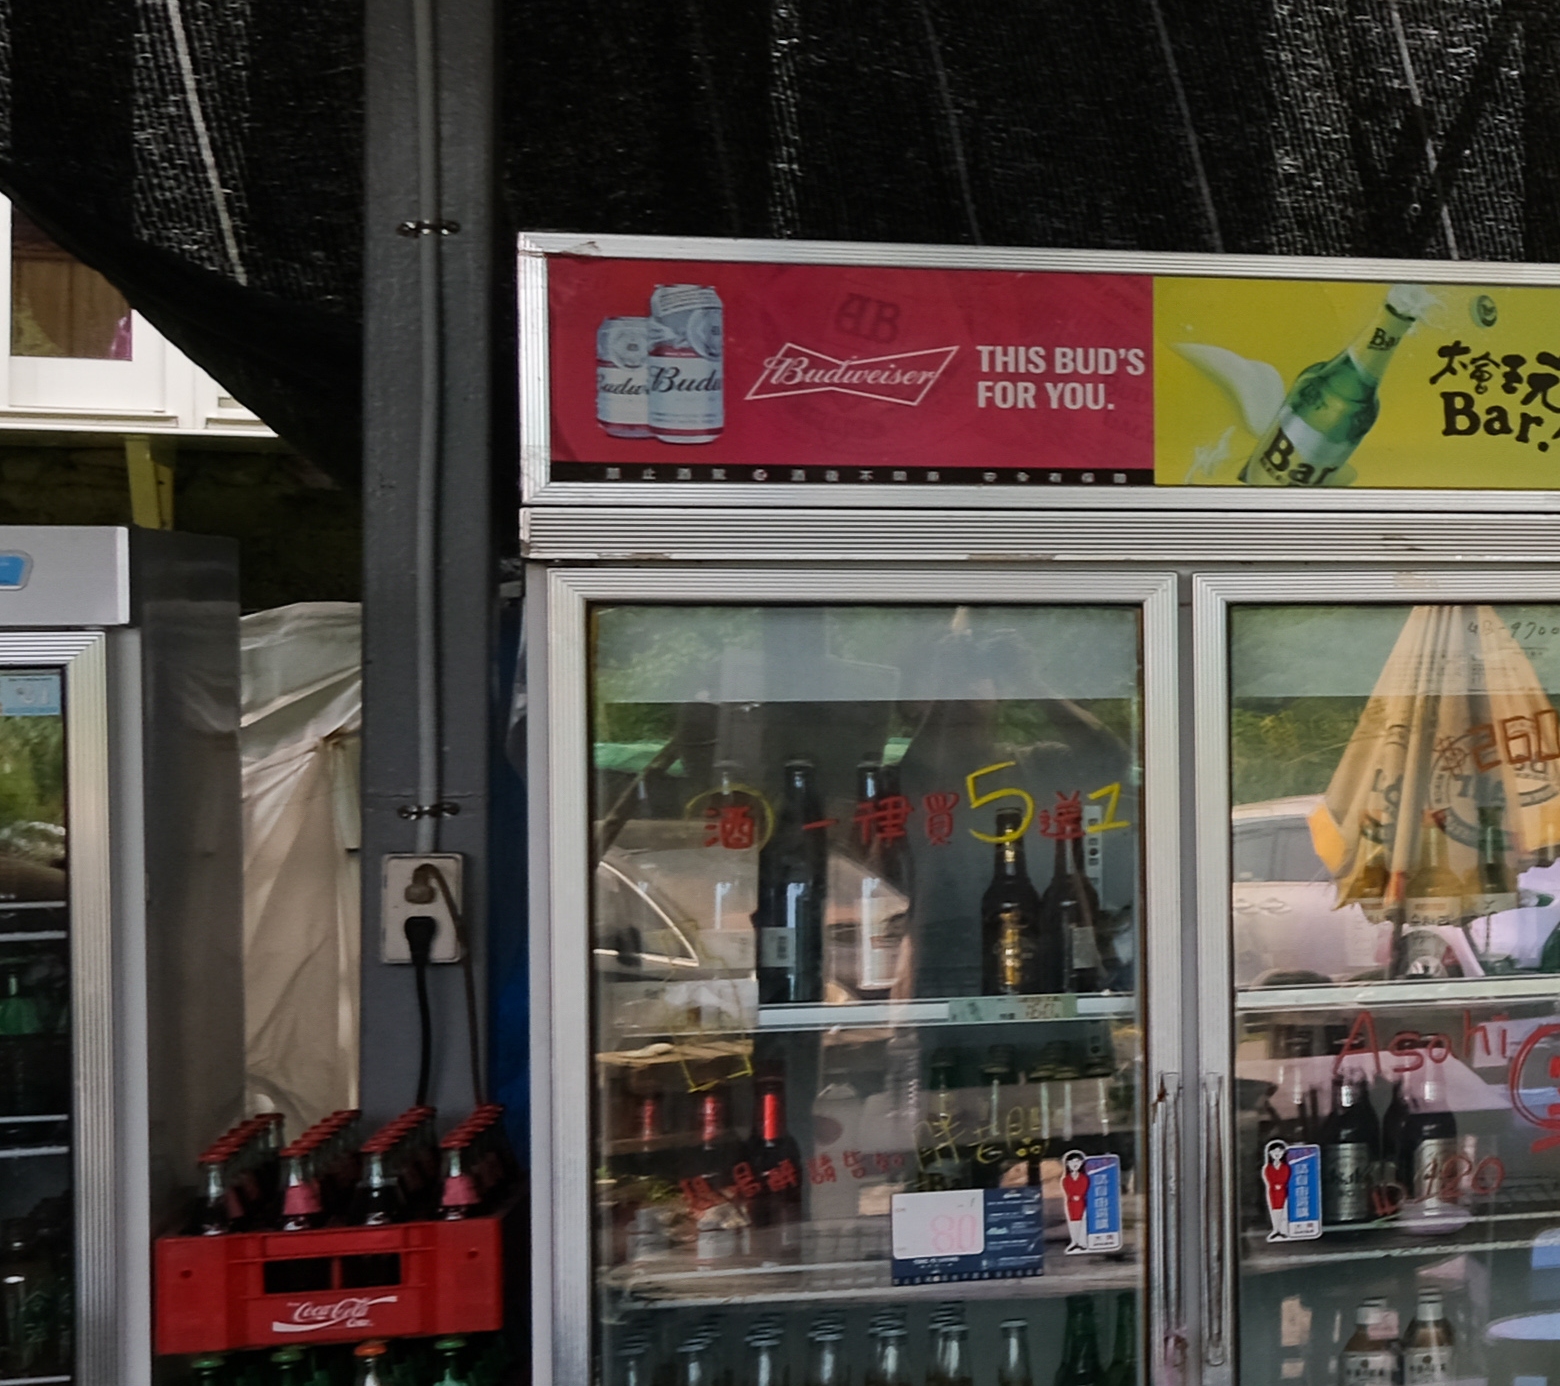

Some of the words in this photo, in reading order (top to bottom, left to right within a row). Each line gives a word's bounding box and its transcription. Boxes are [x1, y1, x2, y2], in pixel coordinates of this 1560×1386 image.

[763, 356, 938, 387] Budweiser
[976, 345, 1047, 374] THIS
[1054, 346, 1146, 376] BUD'S
[977, 380, 1036, 410] FOR
[1044, 381, 1116, 411] YOU.
[1333, 1010, 1509, 1076] Asahi
